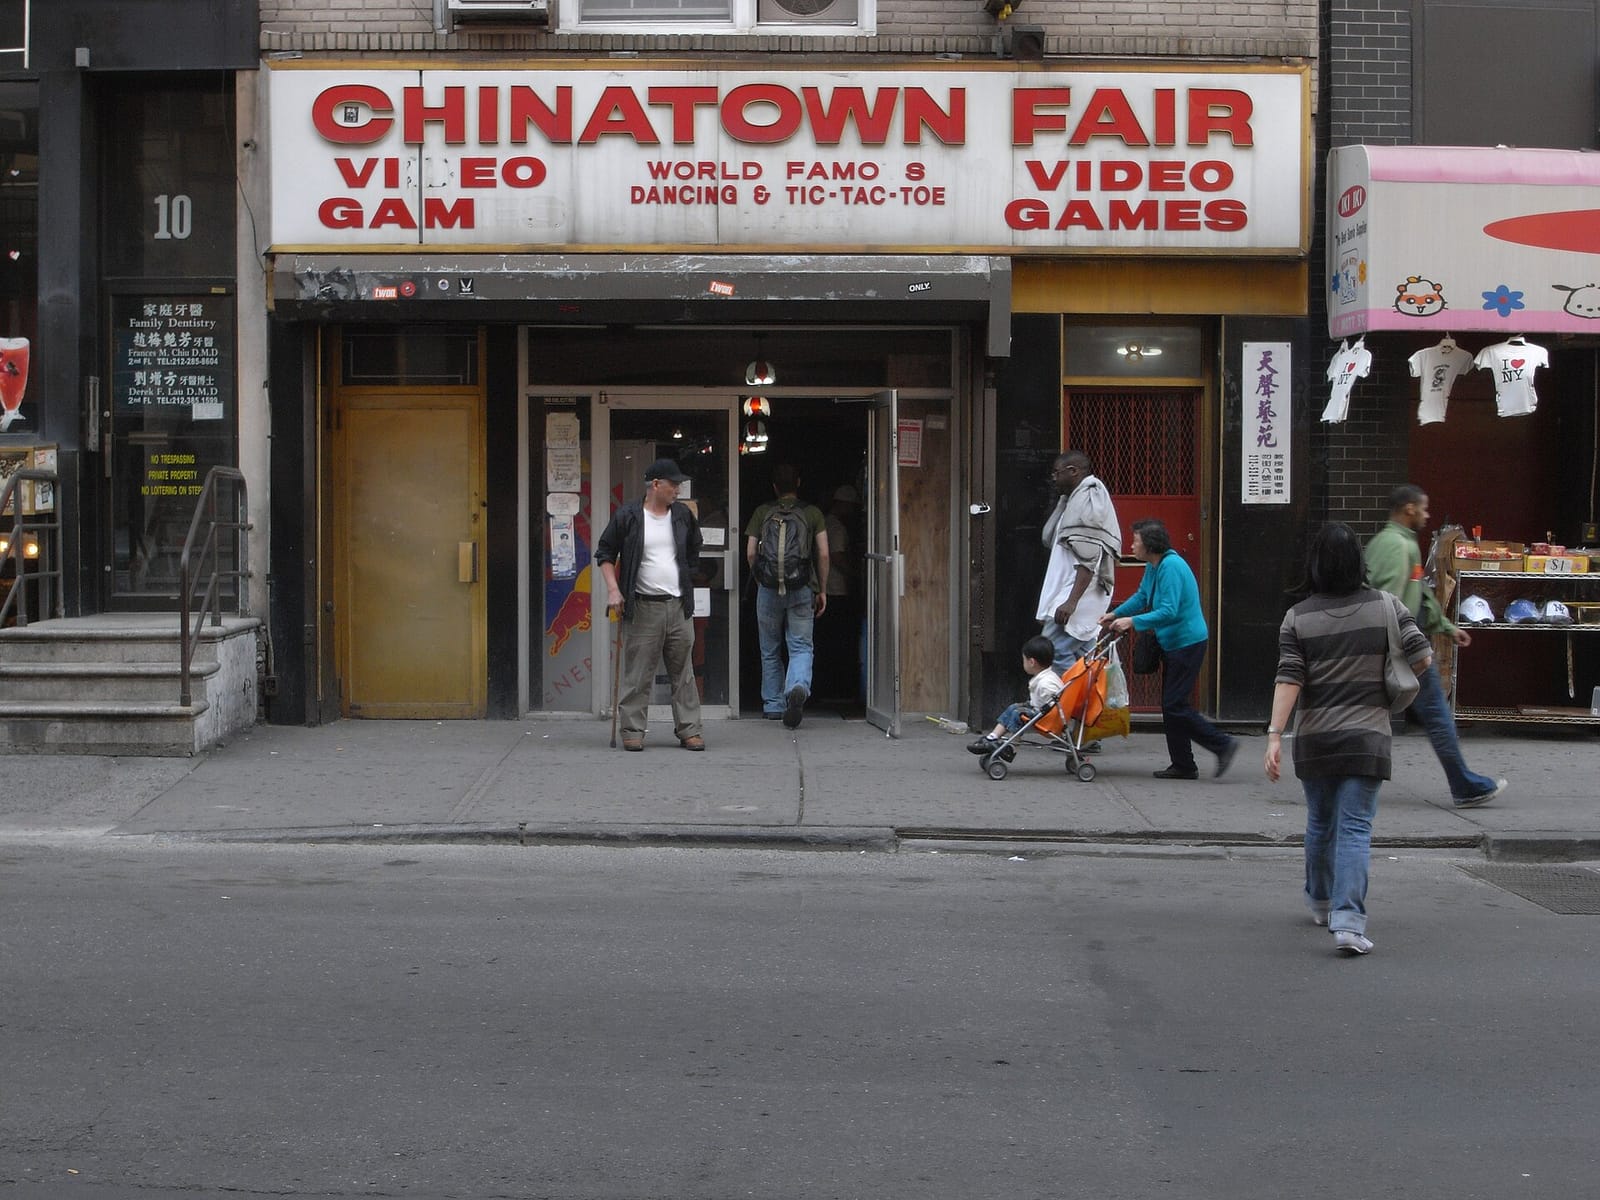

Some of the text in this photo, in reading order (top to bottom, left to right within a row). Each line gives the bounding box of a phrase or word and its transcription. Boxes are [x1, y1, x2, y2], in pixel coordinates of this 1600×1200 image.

[312, 83, 1254, 147] CHINATOWN FAIR
[334, 156, 547, 189] VIEO
[647, 161, 763, 180] WORLD
[1025, 160, 1234, 192] VIDEO
[630, 185, 946, 206] DANCING & TIC-TAC-TOE
[154, 194, 192, 240] 10
[318, 197, 475, 230] GAM
[1004, 198, 1248, 232] GAMES
[143, 303, 203, 317] 家庭牙醫
[129, 318, 216, 330] Family Dentistry
[128, 348, 157, 357] Frances
[192, 348, 218, 357] D.M.D
[143, 357, 152, 365] FL
[1502, 359, 1509, 370] I
[1337, 373, 1352, 385] NY
[1501, 368, 1524, 383] NY
[129, 387, 154, 396] Derek
[168, 387, 184, 396] Lau
[187, 387, 218, 396] D.M.D
[143, 396, 152, 405] FL
[150, 454, 195, 464] NO TRESPASSING
[148, 470, 198, 480] PRIVATE PROPERTY
[141, 485, 204, 495] NO LOITERING ON STEP
